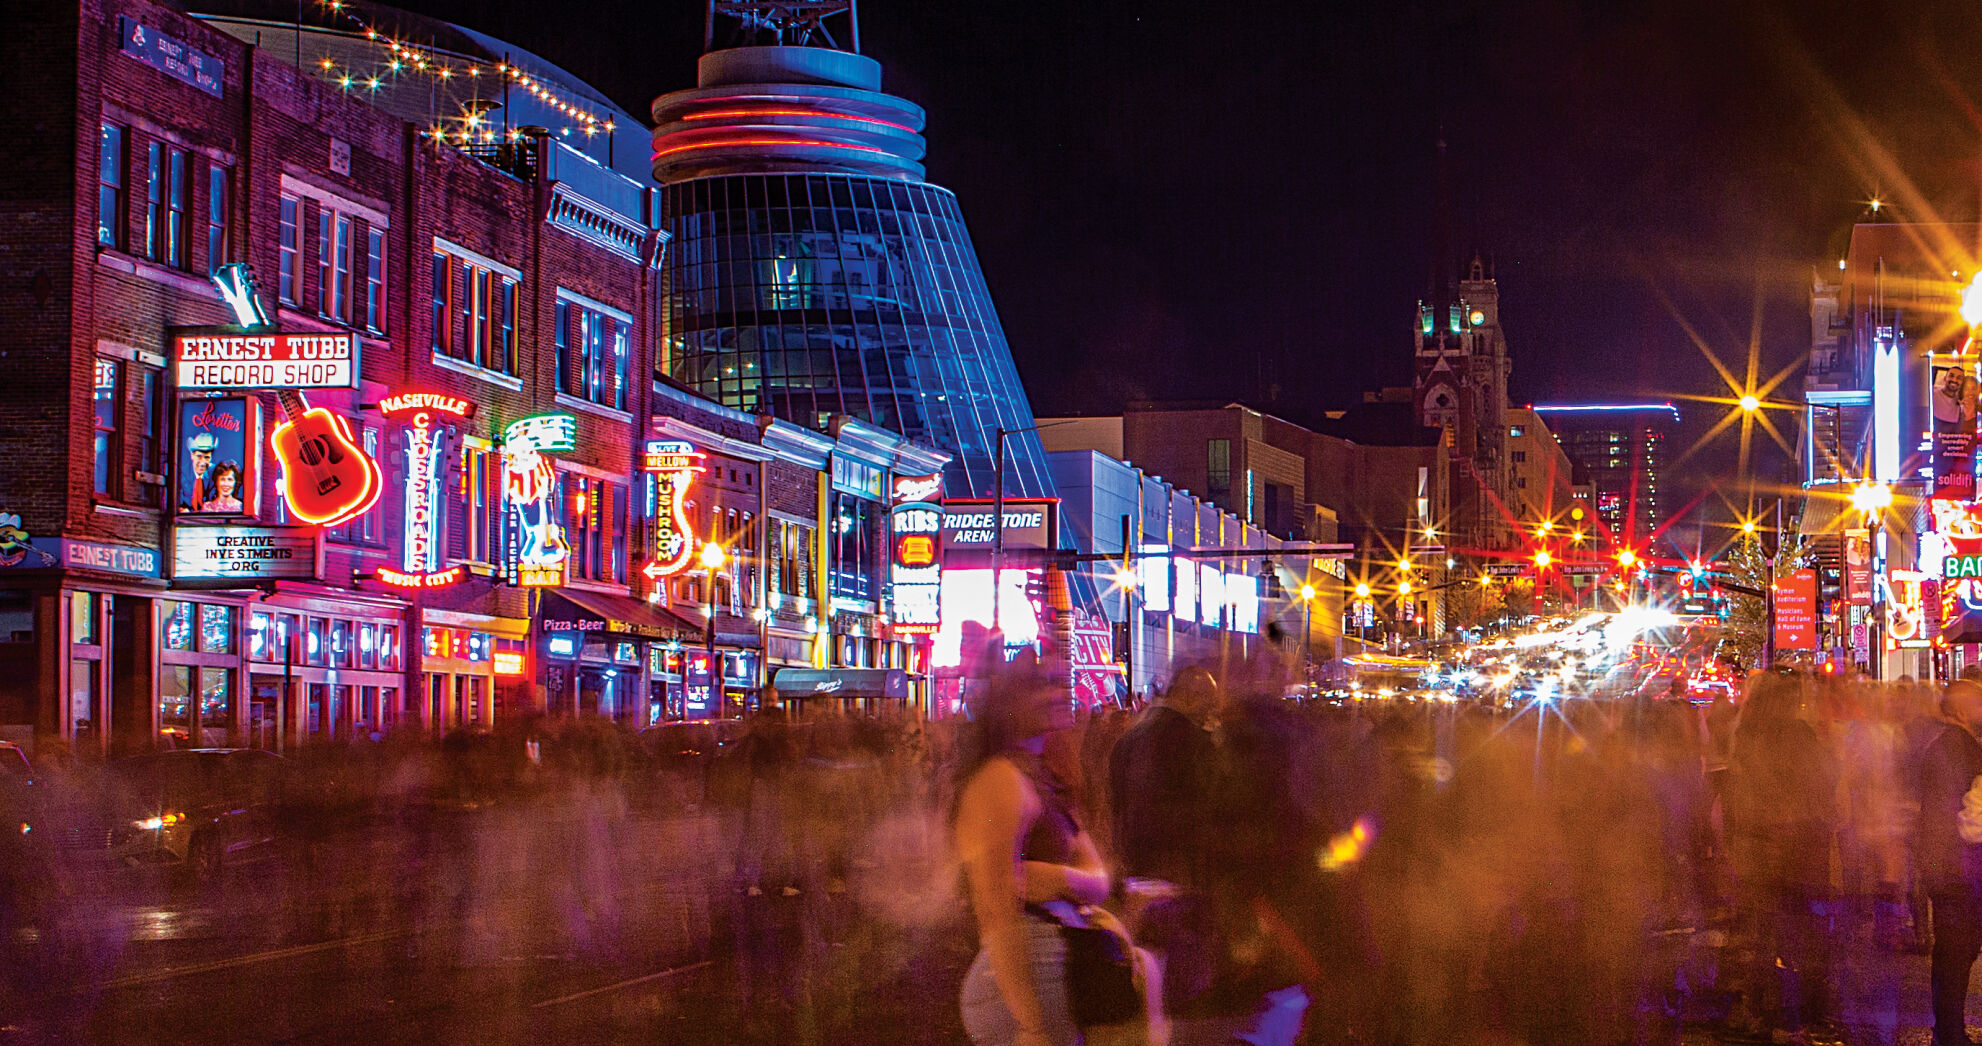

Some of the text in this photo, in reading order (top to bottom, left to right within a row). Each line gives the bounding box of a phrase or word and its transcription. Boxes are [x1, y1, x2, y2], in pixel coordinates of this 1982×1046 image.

[181, 336, 349, 360] ERNEST TUBB
[193, 364, 337, 385] RECORD SHOP
[380, 393, 468, 415] NASHVILLE
[647, 456, 689, 467] MELLOW
[1938, 472, 1973, 488] solidifi
[412, 412, 430, 572] CROSSROADS
[657, 472, 673, 562] MUSHROOM
[893, 510, 939, 532] RIBS
[942, 512, 1042, 529] RIDGETONE
[217, 536, 275, 547] CREATIVE
[69, 543, 154, 572] ERNEST TUBB
[231, 561, 260, 571] ORG
[543, 619, 571, 632] Pizza
[578, 619, 605, 631] Beer
[1075, 635, 1113, 664] CITY
